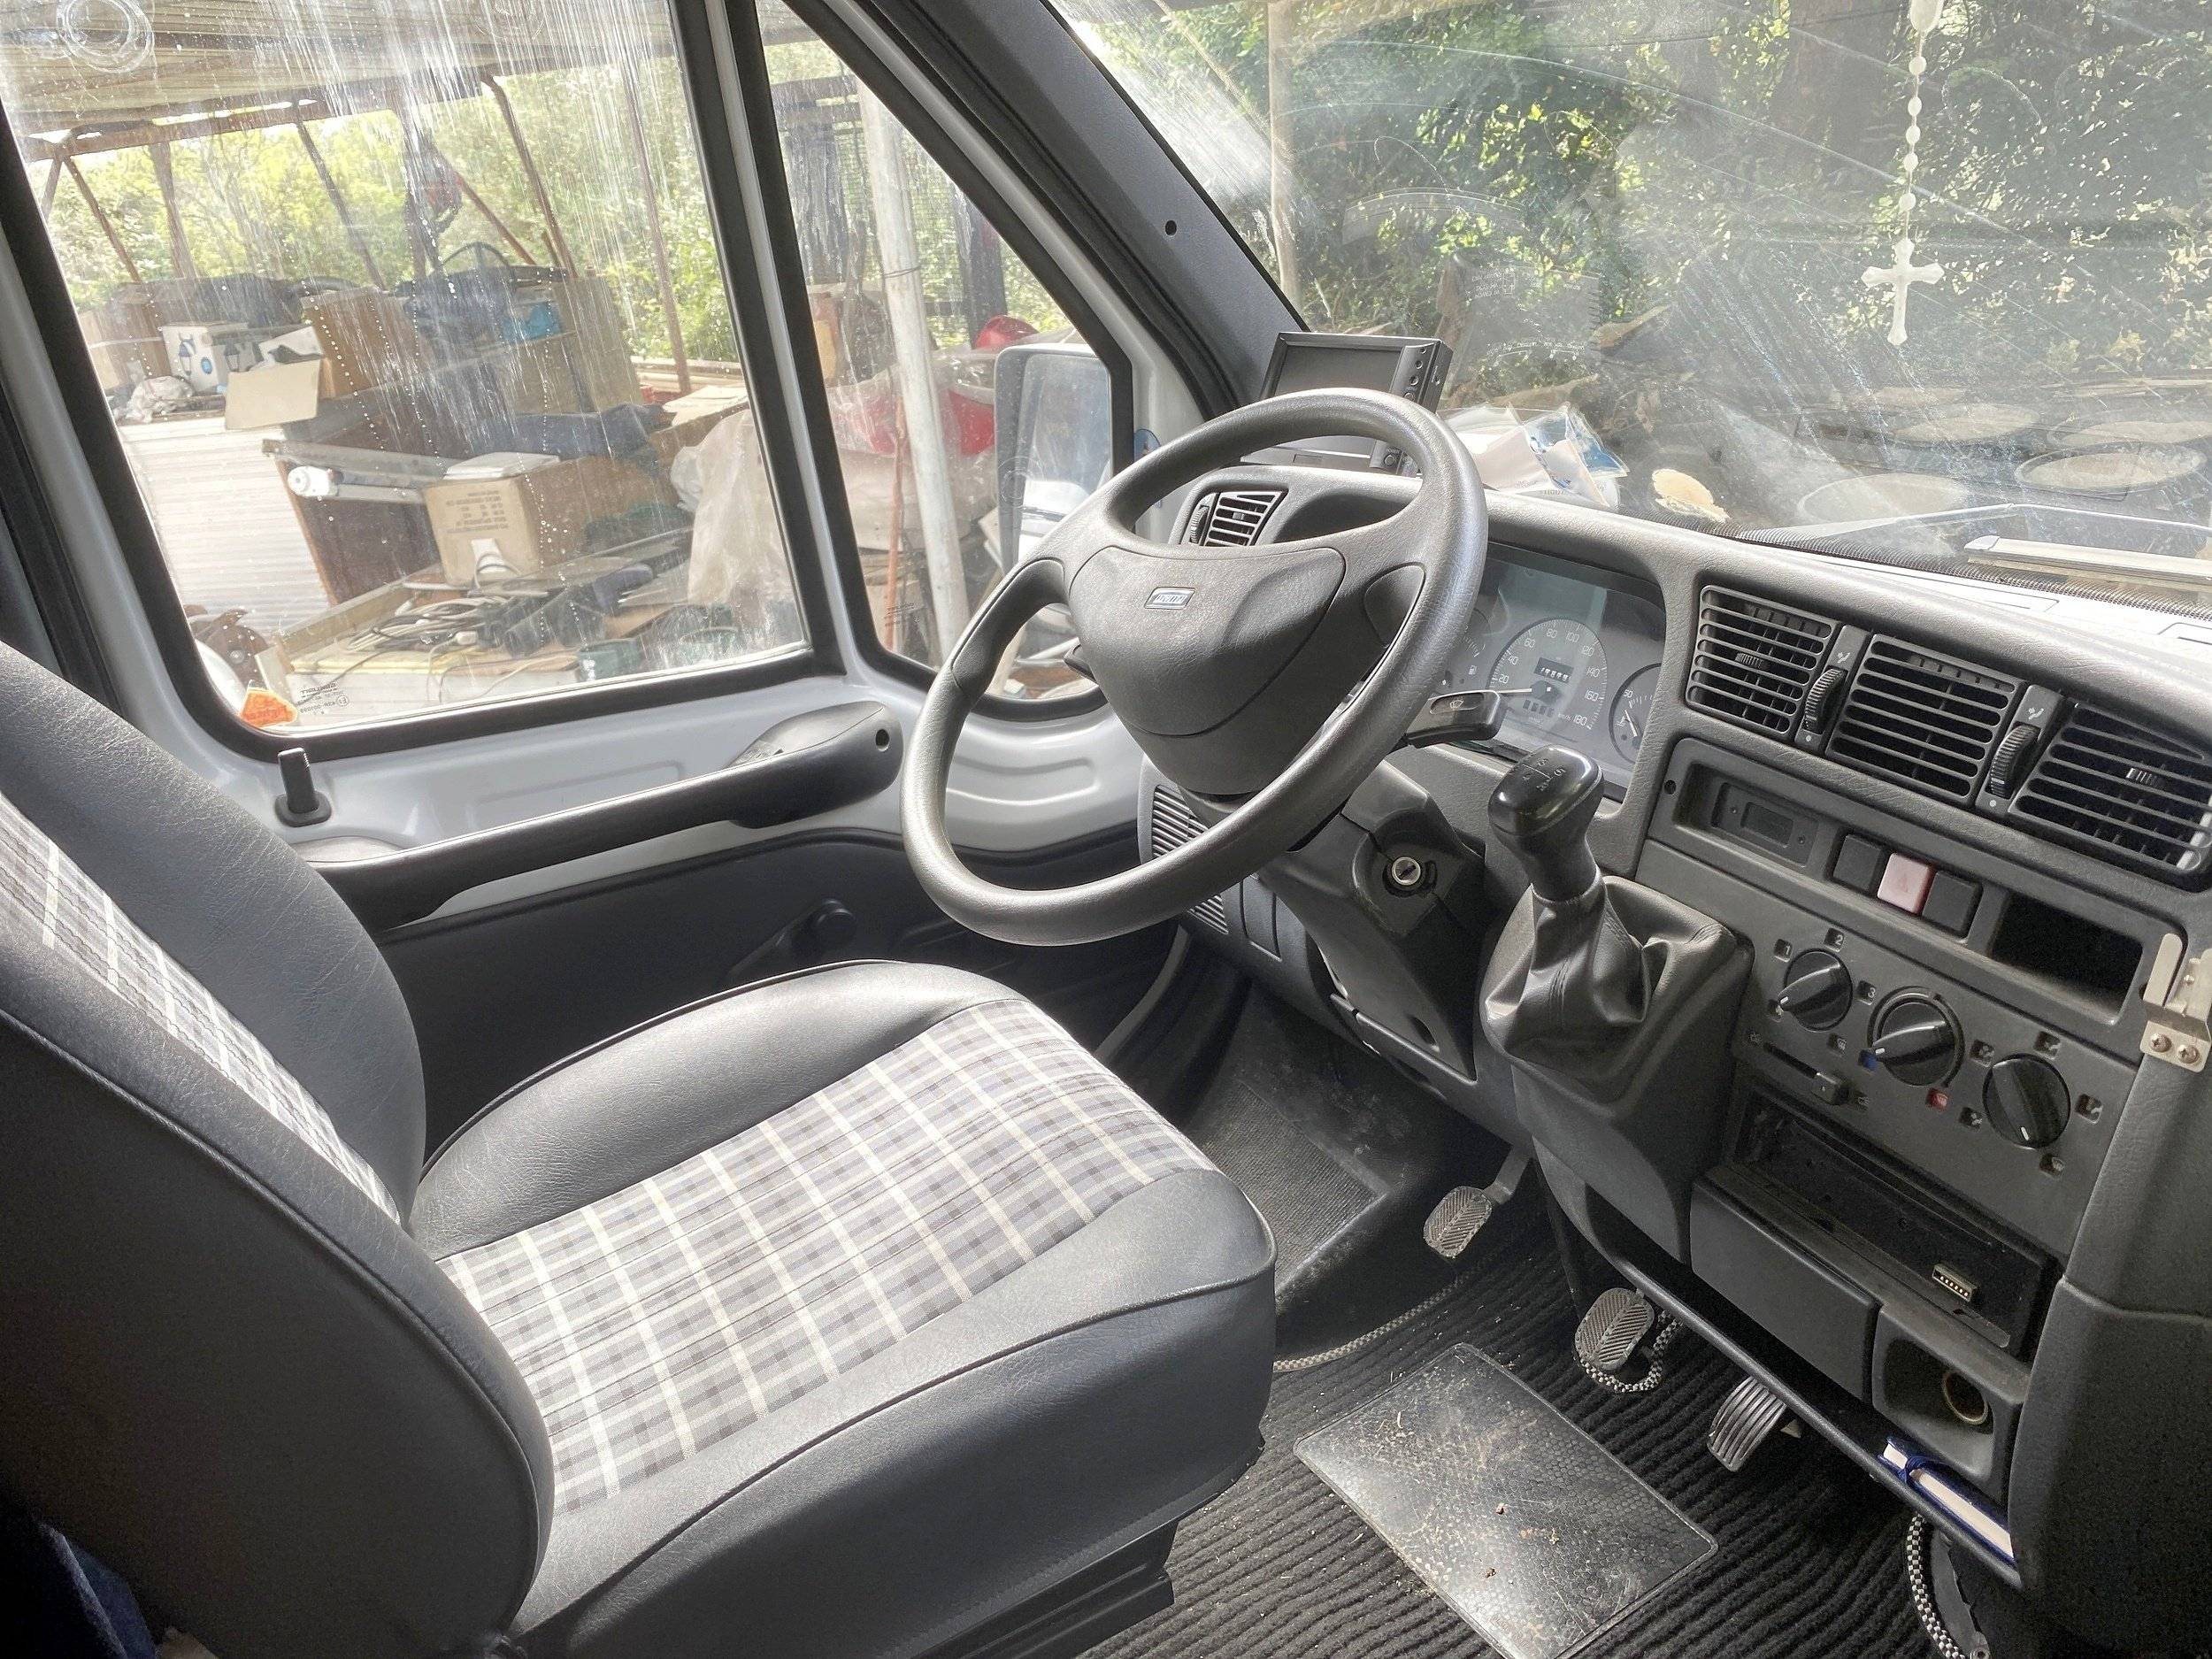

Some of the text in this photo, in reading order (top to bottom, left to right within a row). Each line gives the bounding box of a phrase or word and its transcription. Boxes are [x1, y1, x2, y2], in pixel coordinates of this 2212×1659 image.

[1546, 628, 1558, 639] 80
[1565, 632, 1580, 642] 100
[1524, 637, 1536, 649] 60
[1579, 645, 1594, 657] 120
[1508, 655, 1519, 665] 40
[1586, 666, 1601, 678] 140
[1498, 673, 1509, 684] 20
[1585, 690, 1600, 702] 160
[1623, 689, 1634, 698] 50
[1573, 714, 1588, 726] 180
[1834, 934, 1844, 946] 2
[1785, 945, 1791, 956] 1
[1867, 987, 1877, 998] 3
